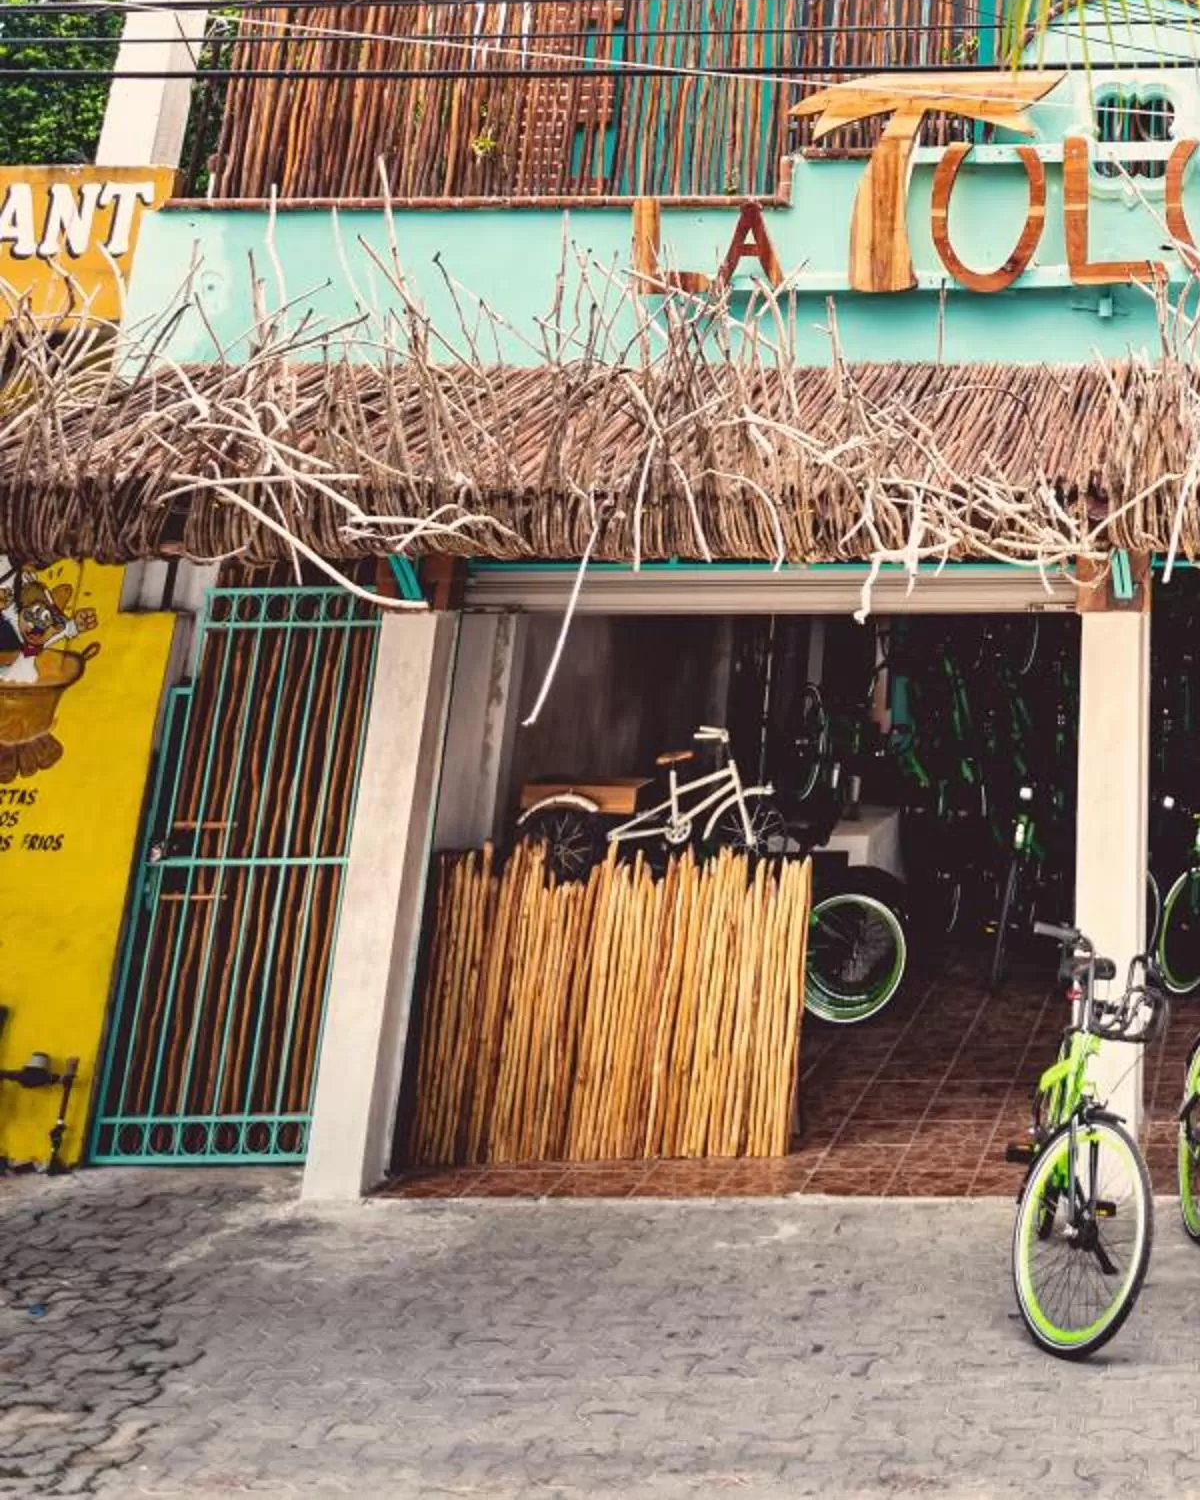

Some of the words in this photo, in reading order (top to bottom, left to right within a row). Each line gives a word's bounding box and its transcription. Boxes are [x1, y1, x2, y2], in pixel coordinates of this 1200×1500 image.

[0, 180, 156, 259] ANT
[633, 196, 785, 296] LA
[21, 832, 65, 852] FRIOS
